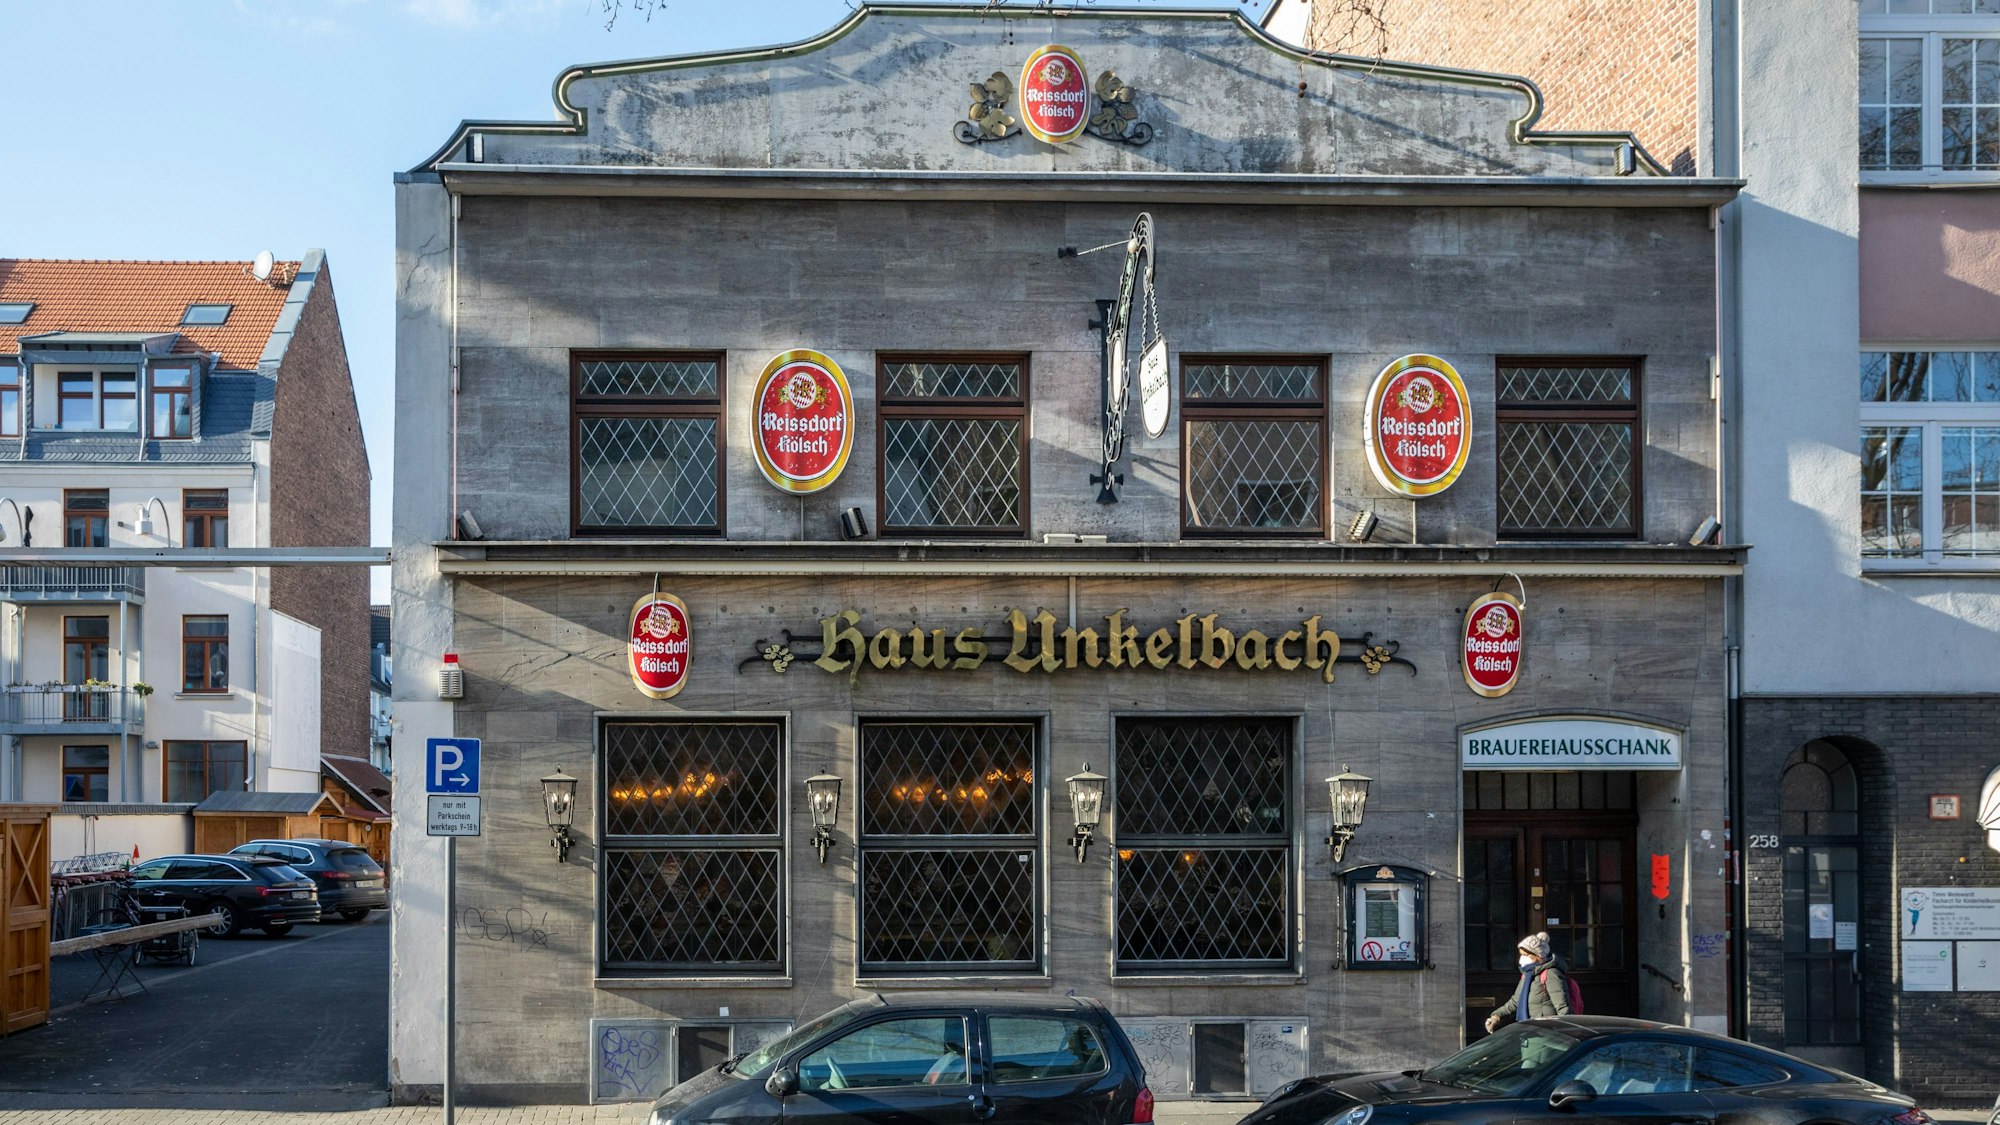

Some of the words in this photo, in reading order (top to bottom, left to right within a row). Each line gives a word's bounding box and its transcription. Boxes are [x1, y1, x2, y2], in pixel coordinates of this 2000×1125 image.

[1026, 88, 1084, 103] Reissdorf
[1037, 103, 1075, 119] Kölsch
[762, 411, 843, 432] Reissdorf
[1381, 416, 1461, 437] Reissdorf
[775, 435, 828, 456] Kölsch
[1394, 439, 1446, 460] Kölsch
[633, 637, 688, 654] Reissdorf
[814, 610, 989, 690] Haus
[1002, 608, 1341, 684] Unkelbach
[1467, 637, 1520, 654] Reissdorf
[640, 656, 680, 675] Kölsch
[1474, 656, 1512, 673] Kölsch
[1469, 738, 1672, 756] BRAUEREIAUSSCHANK
[435, 745, 463, 786] P
[437, 812, 470, 820] Parkschein
[430, 823, 458, 832] werktags
[1749, 834, 1779, 848] 258
